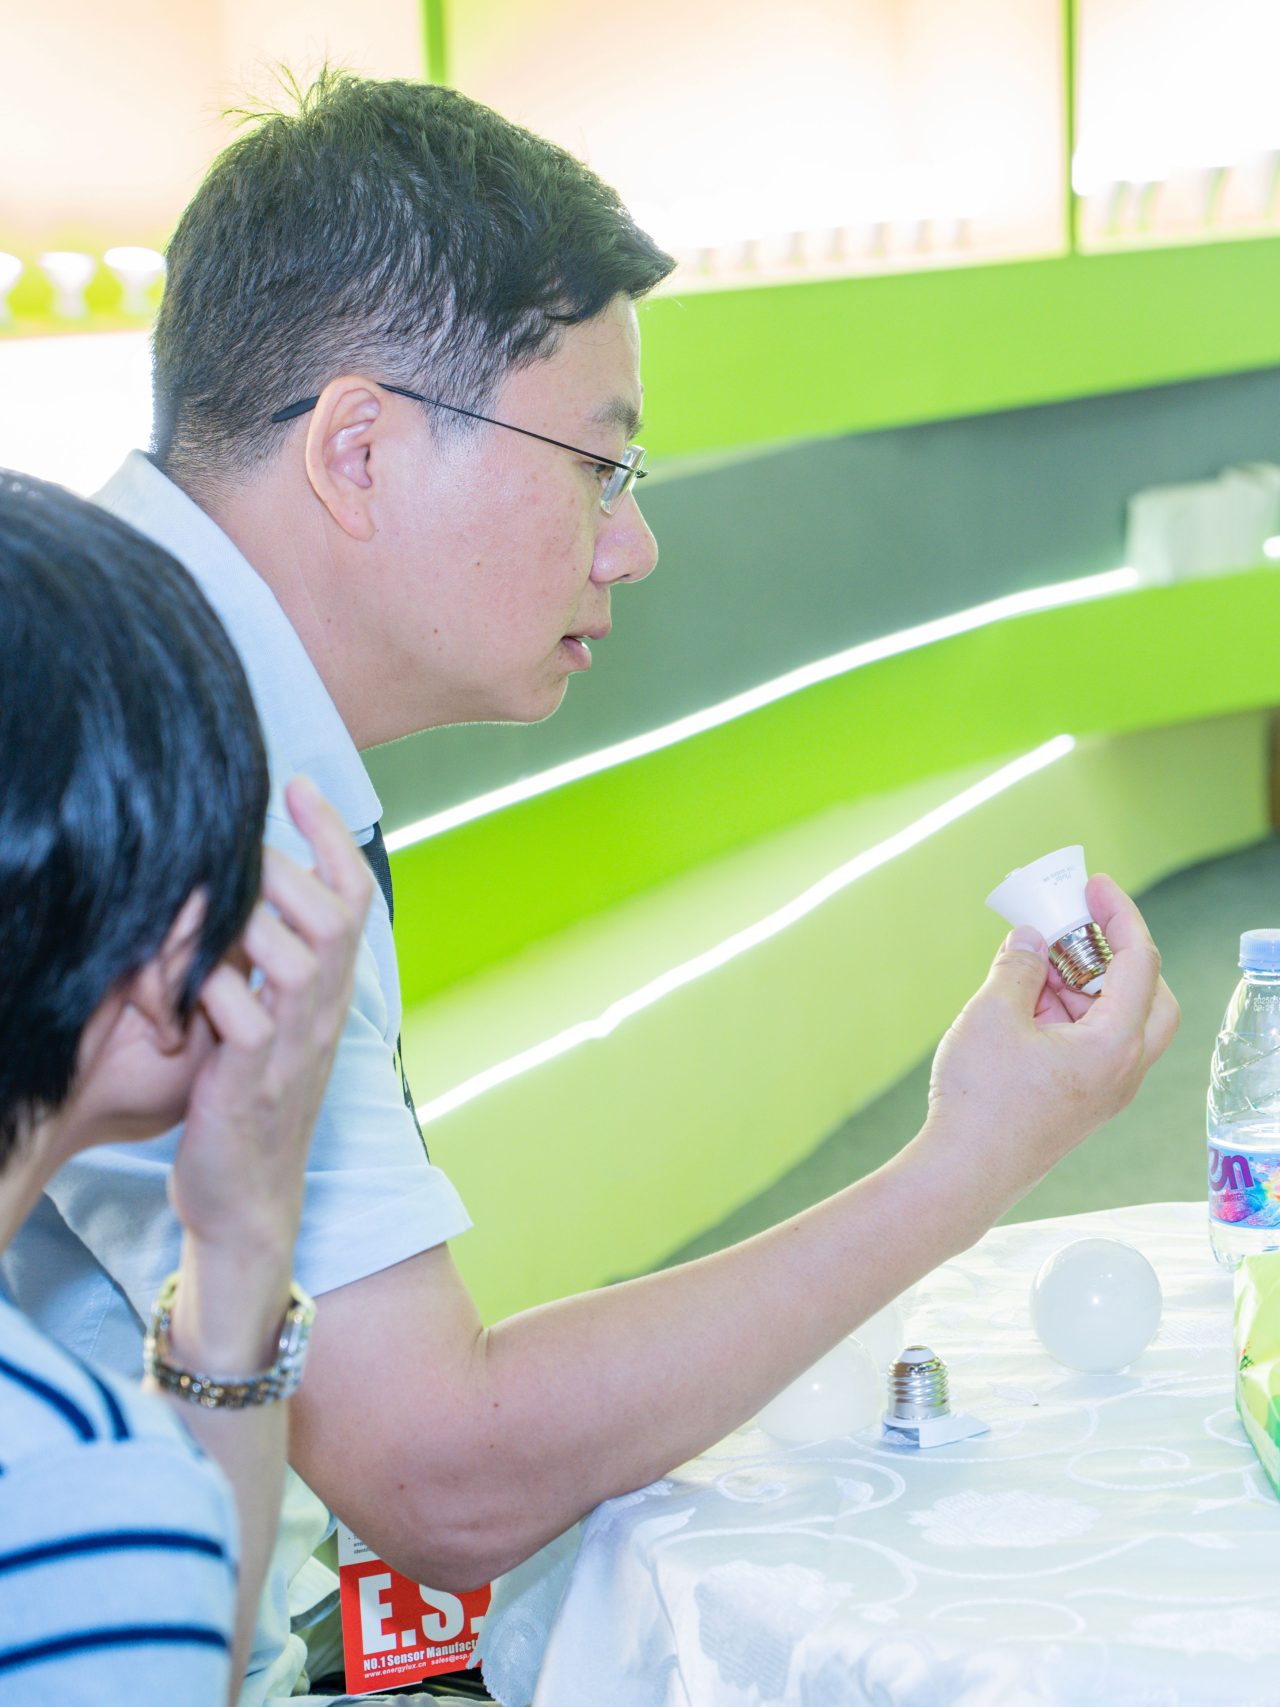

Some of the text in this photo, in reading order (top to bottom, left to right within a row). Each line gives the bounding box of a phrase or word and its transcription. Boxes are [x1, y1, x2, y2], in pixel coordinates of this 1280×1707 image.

[363, 1657, 386, 1672] NO.1
[387, 1649, 425, 1666] Sensor
[363, 1652, 473, 1679] www.energylux.cn sales@esp.
